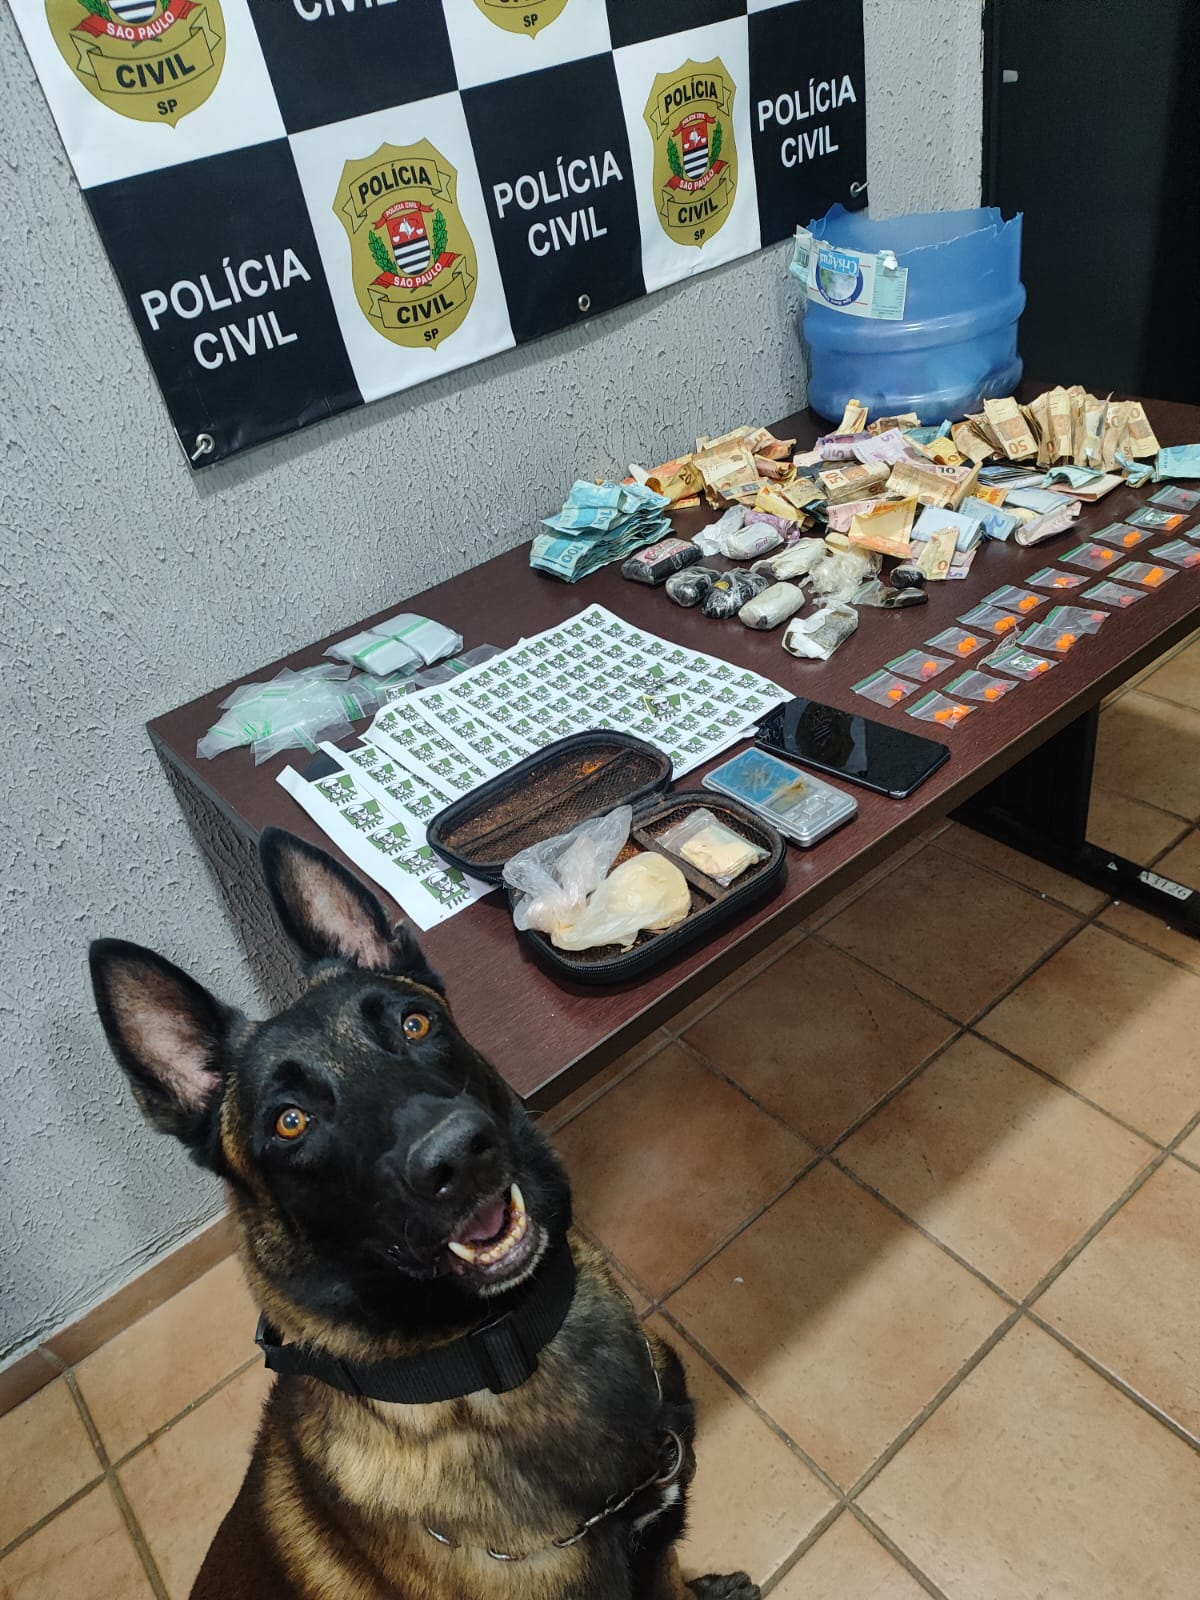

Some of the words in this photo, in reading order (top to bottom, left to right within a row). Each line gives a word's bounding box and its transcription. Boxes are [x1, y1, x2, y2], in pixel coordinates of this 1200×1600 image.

[137, 11, 175, 40] PAULO
[523, 14, 538, 28] SP
[115, 53, 196, 88] CIVIL
[156, 98, 178, 116] SP
[664, 77, 718, 114] POLÍCIA
[757, 74, 857, 132] POLÍCIA
[781, 125, 839, 168] CIVIL
[358, 163, 432, 205] POLÍCIA
[493, 150, 624, 219] POLÍCIA
[694, 169, 714, 190] PAULO
[678, 197, 719, 224] CIVIL
[528, 206, 608, 257] CIVIL
[694, 228, 706, 241] SP
[415, 262, 442, 287] PAULO
[140, 248, 312, 331] POLÍCIA
[396, 293, 455, 324] CIVIL
[193, 310, 299, 370] CIVIL
[423, 328, 439, 342] SP
[678, 467, 693, 486] 20
[561, 544, 584, 563] 100
[445, 891, 473, 910] THC
